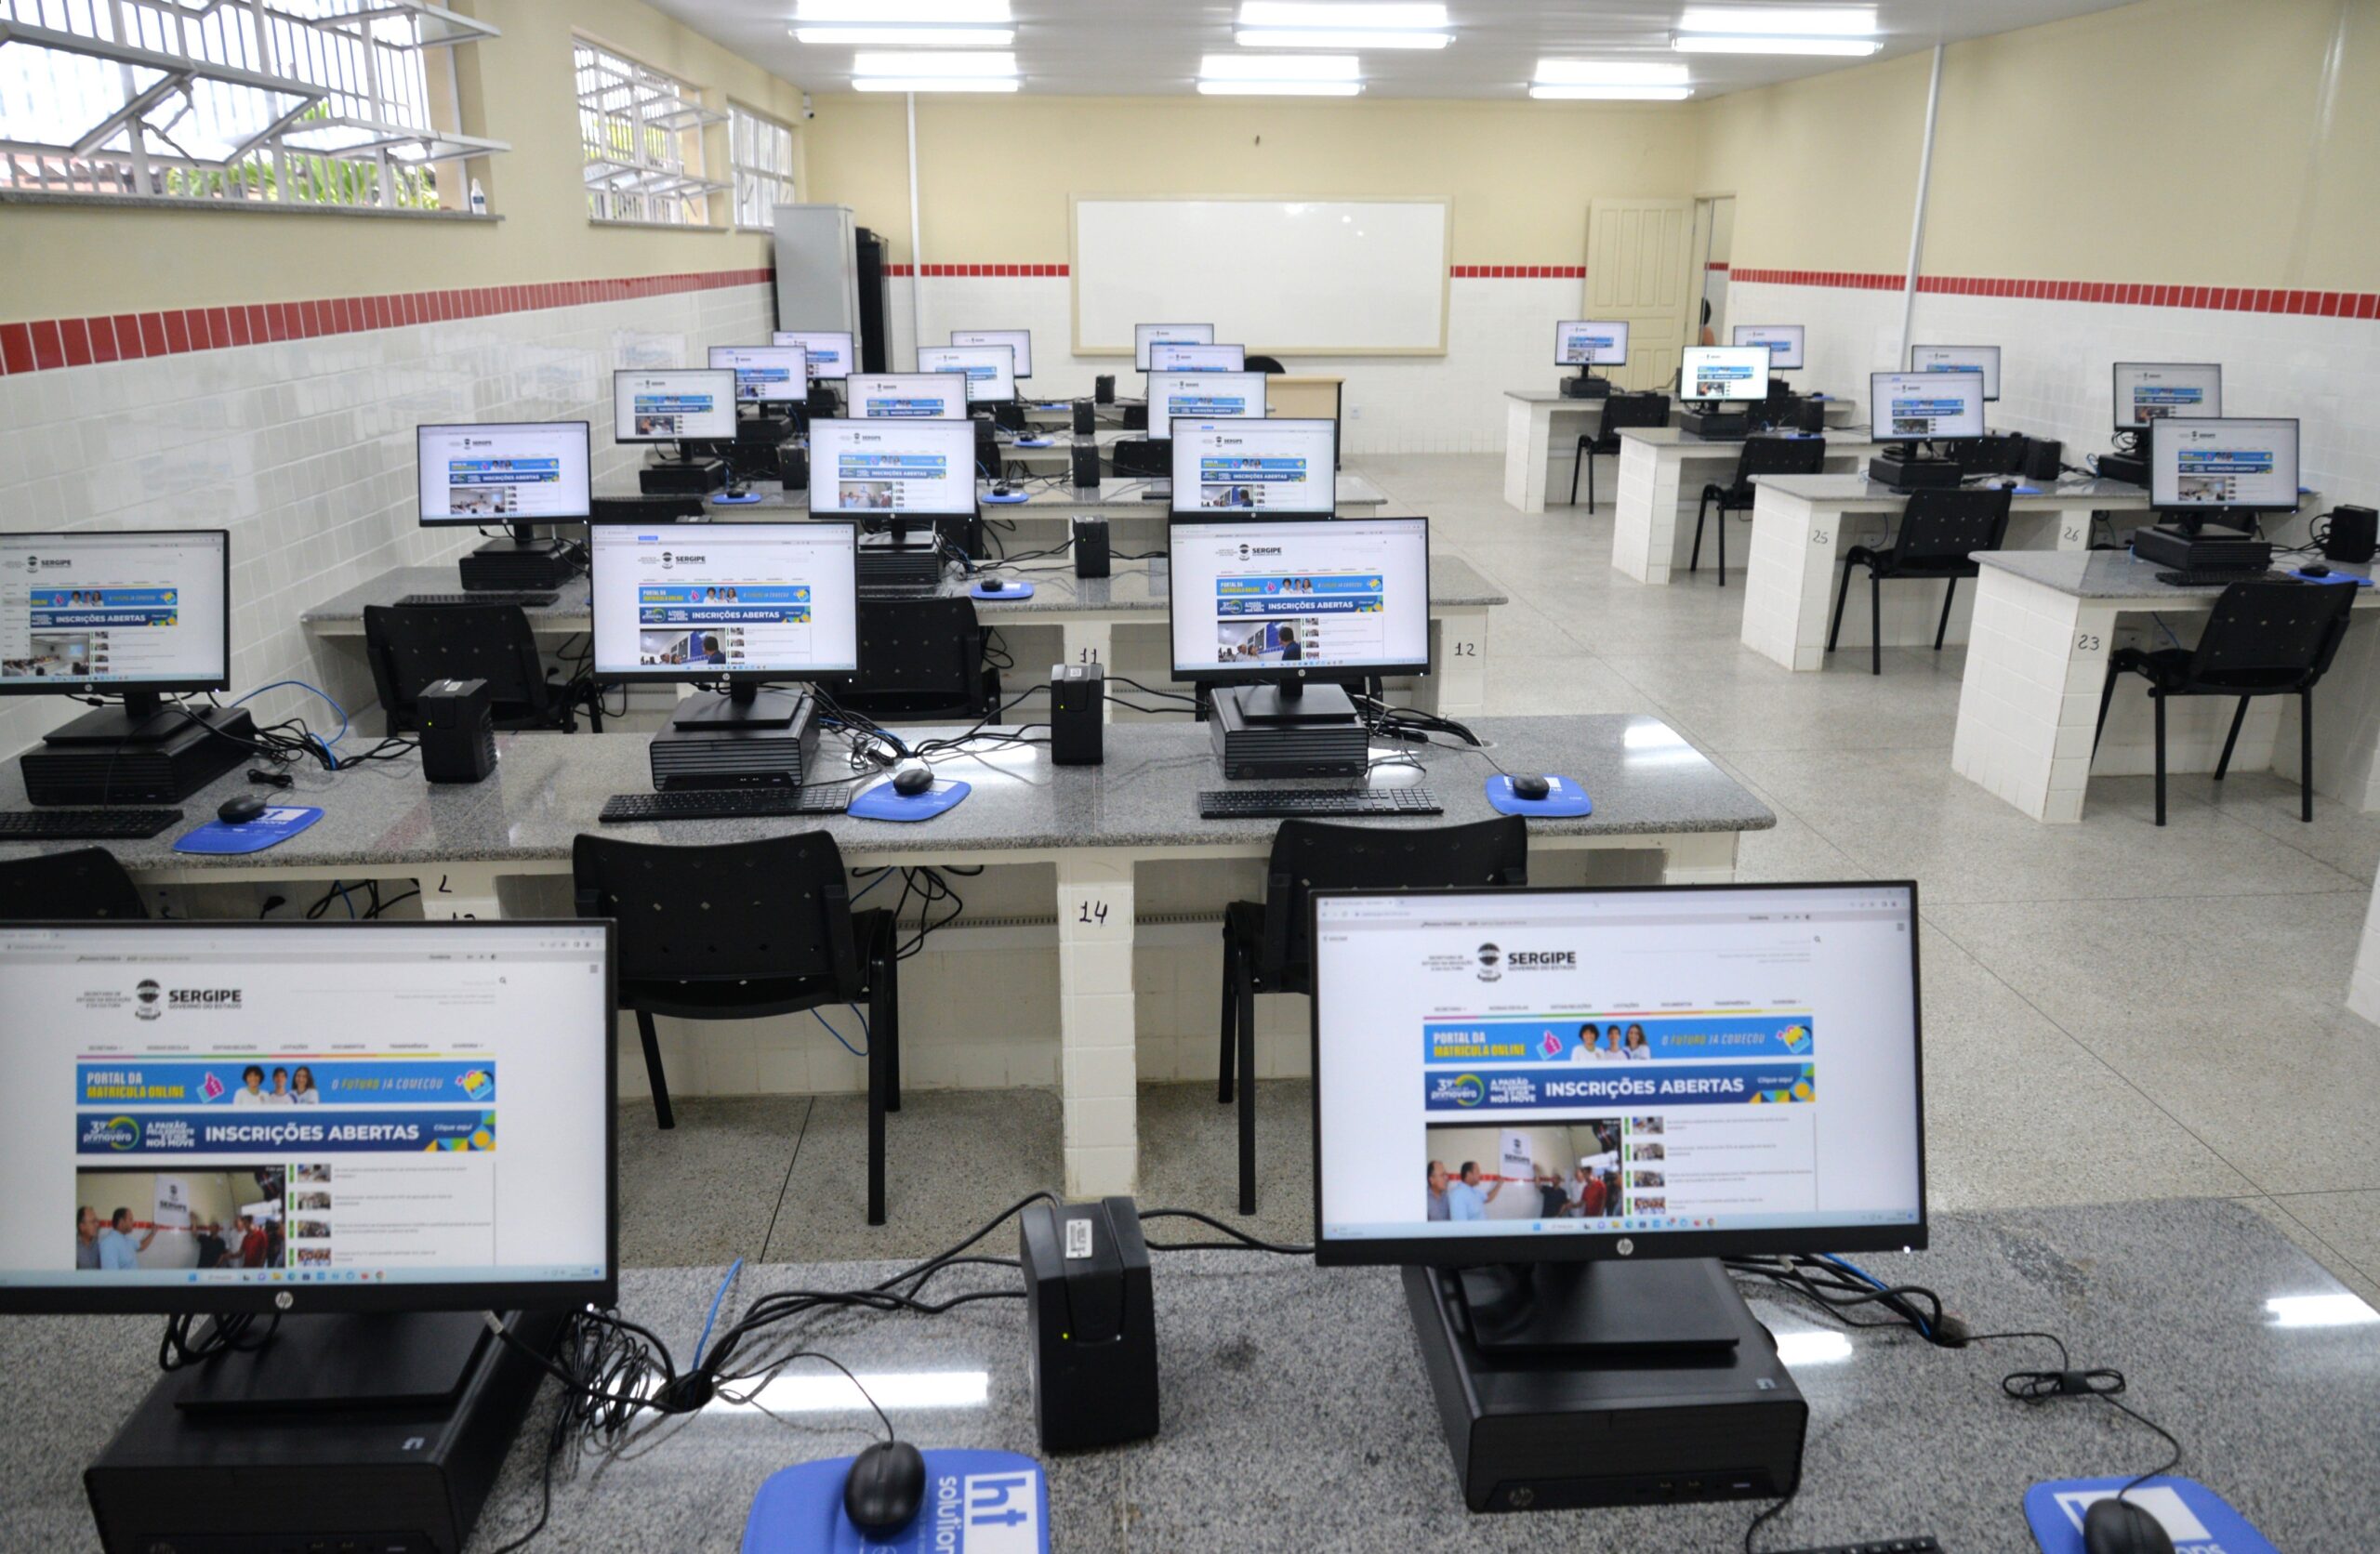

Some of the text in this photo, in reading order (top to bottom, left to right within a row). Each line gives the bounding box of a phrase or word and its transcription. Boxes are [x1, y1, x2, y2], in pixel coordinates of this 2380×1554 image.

[2064, 526, 2080, 542] 26
[1268, 599, 1316, 611] INSCRIÇÕES
[56, 613, 105, 624] INSCRIÇÕES
[107, 614, 146, 623] ABERTAS
[692, 610, 741, 620] INSCRIÇÕES
[742, 611, 780, 619] ABERTAS
[1454, 642, 1476, 656] 12
[2078, 634, 2100, 651] 23
[1079, 900, 1108, 925] 14
[1508, 951, 1577, 965] SERGIPE
[168, 989, 242, 1003] SERGIPE
[1433, 1031, 1486, 1045] PORTAL DA
[1491, 1044, 1526, 1056] ONLINE
[86, 1072, 142, 1086] PORTAL DA
[396, 1077, 443, 1090] COMEÇOU
[148, 1086, 185, 1099] ONLINE
[1545, 1076, 1745, 1099] INSCRIÇÕES ABERTAS
[205, 1122, 324, 1145] INSCRIÇÕES
[327, 1125, 419, 1141] ABERTAS
[972, 1477, 1027, 1527] ht
